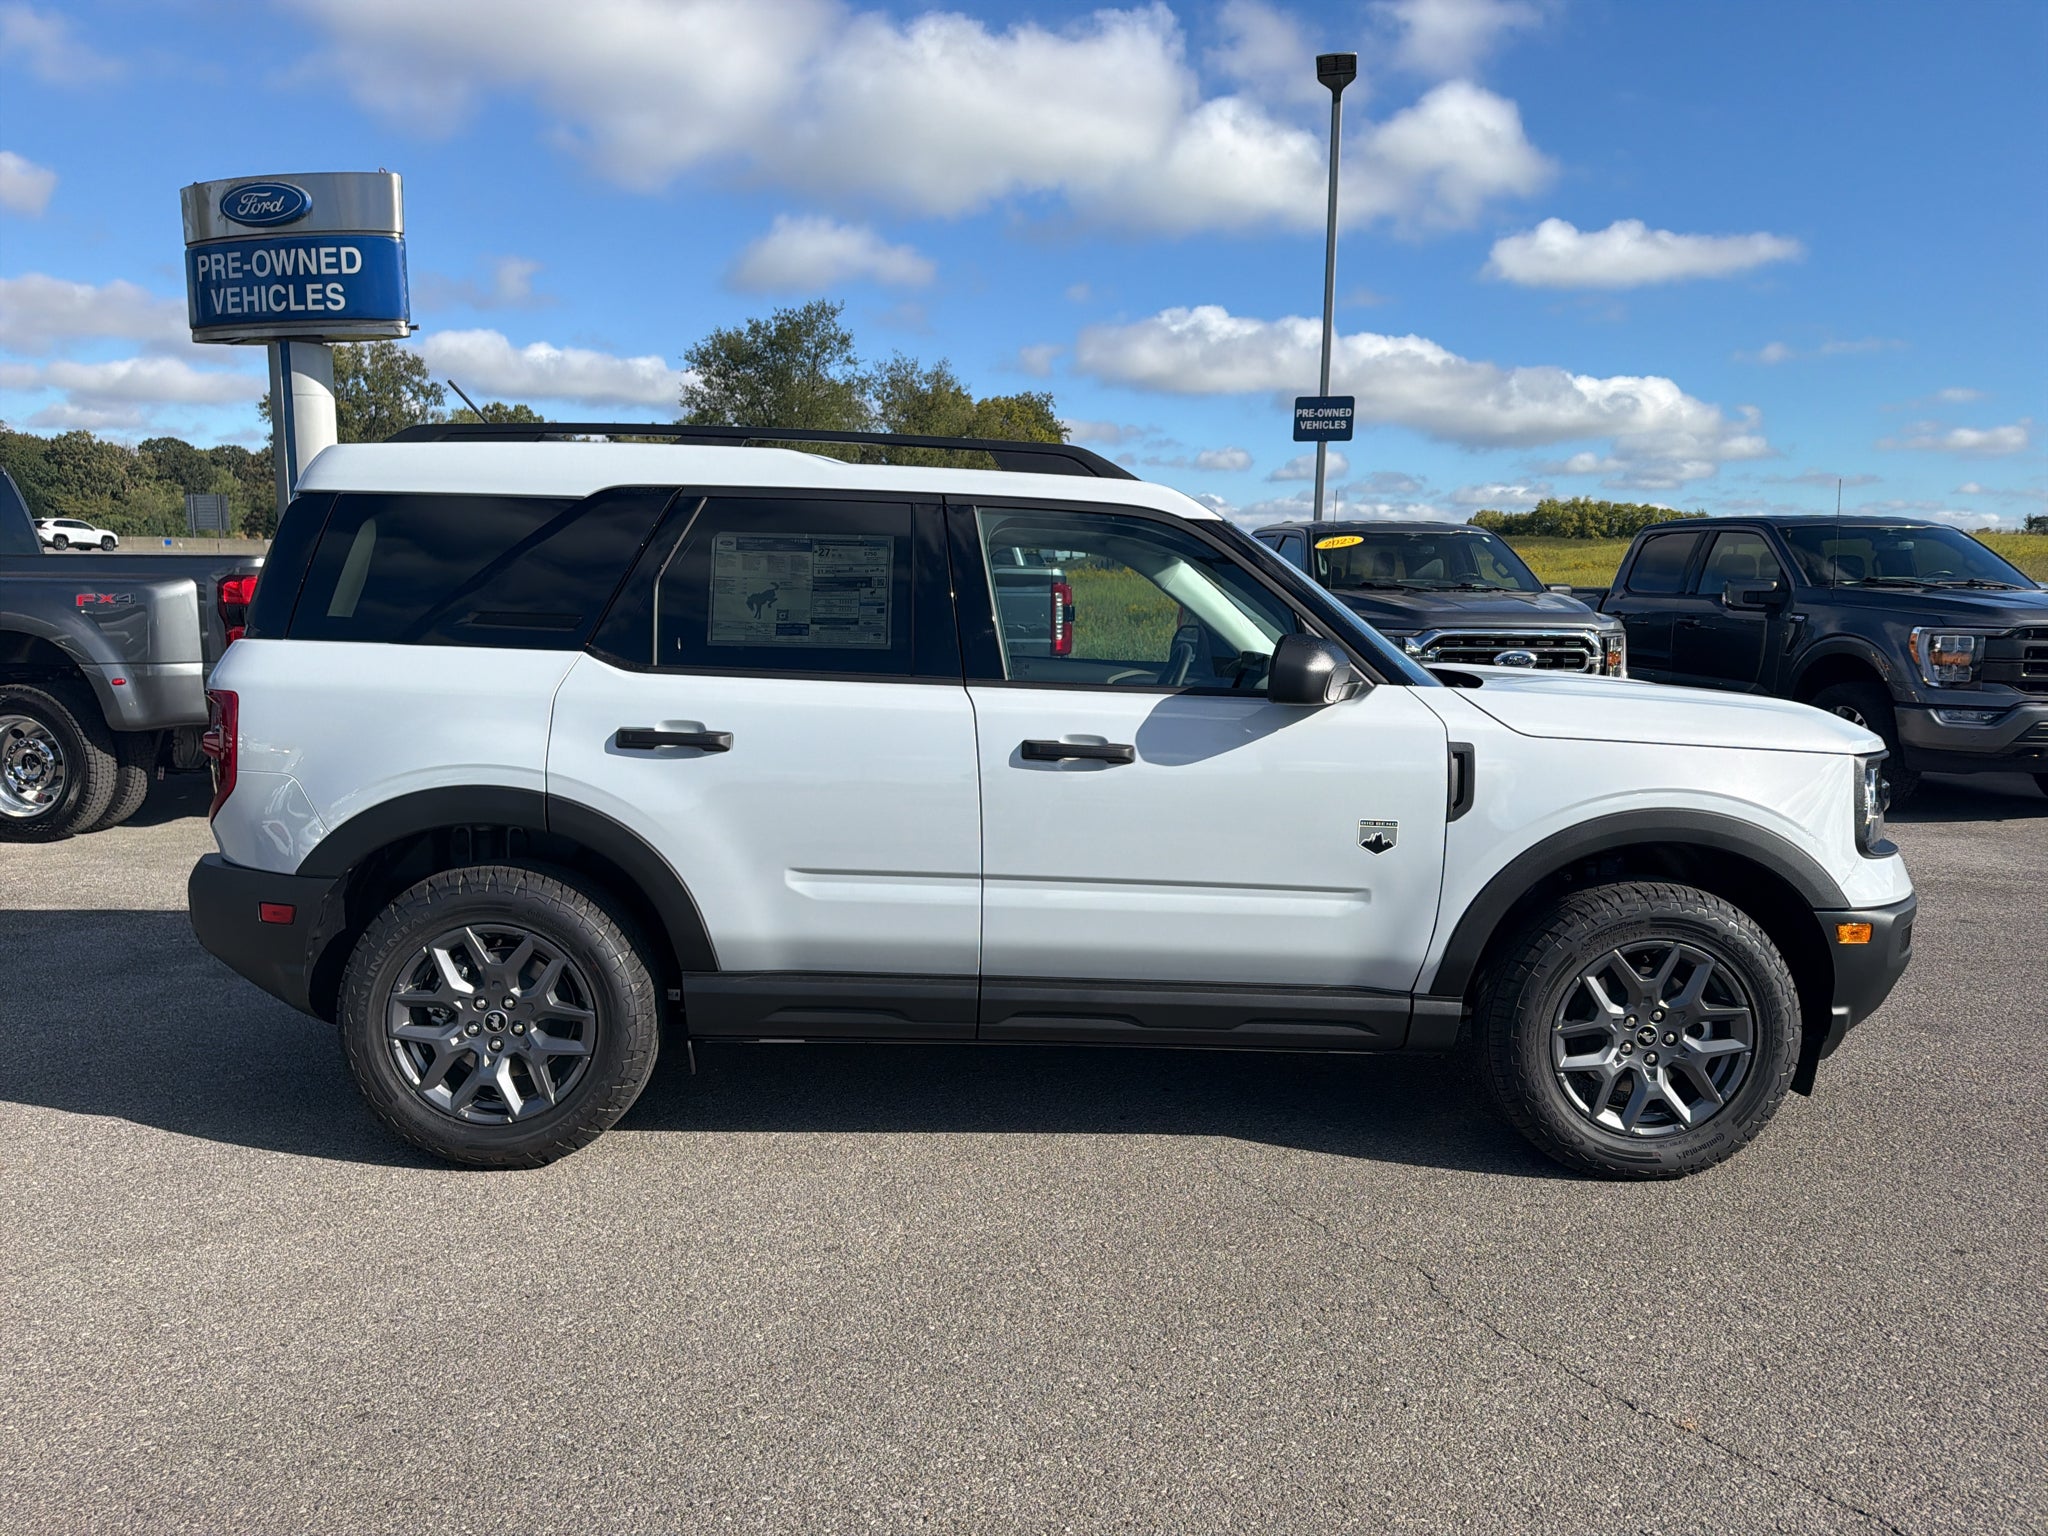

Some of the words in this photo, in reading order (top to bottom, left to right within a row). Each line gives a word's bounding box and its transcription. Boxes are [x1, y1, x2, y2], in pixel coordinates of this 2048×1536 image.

[237, 192, 284, 215] Ford
[197, 246, 362, 282] PRE-OWNED
[211, 283, 346, 315] VEHICLES
[1296, 408, 1352, 418] PRE-OWNED
[1300, 420, 1347, 430] VEHICLES
[1325, 537, 1355, 547] 2023
[76, 593, 136, 606] FX4
